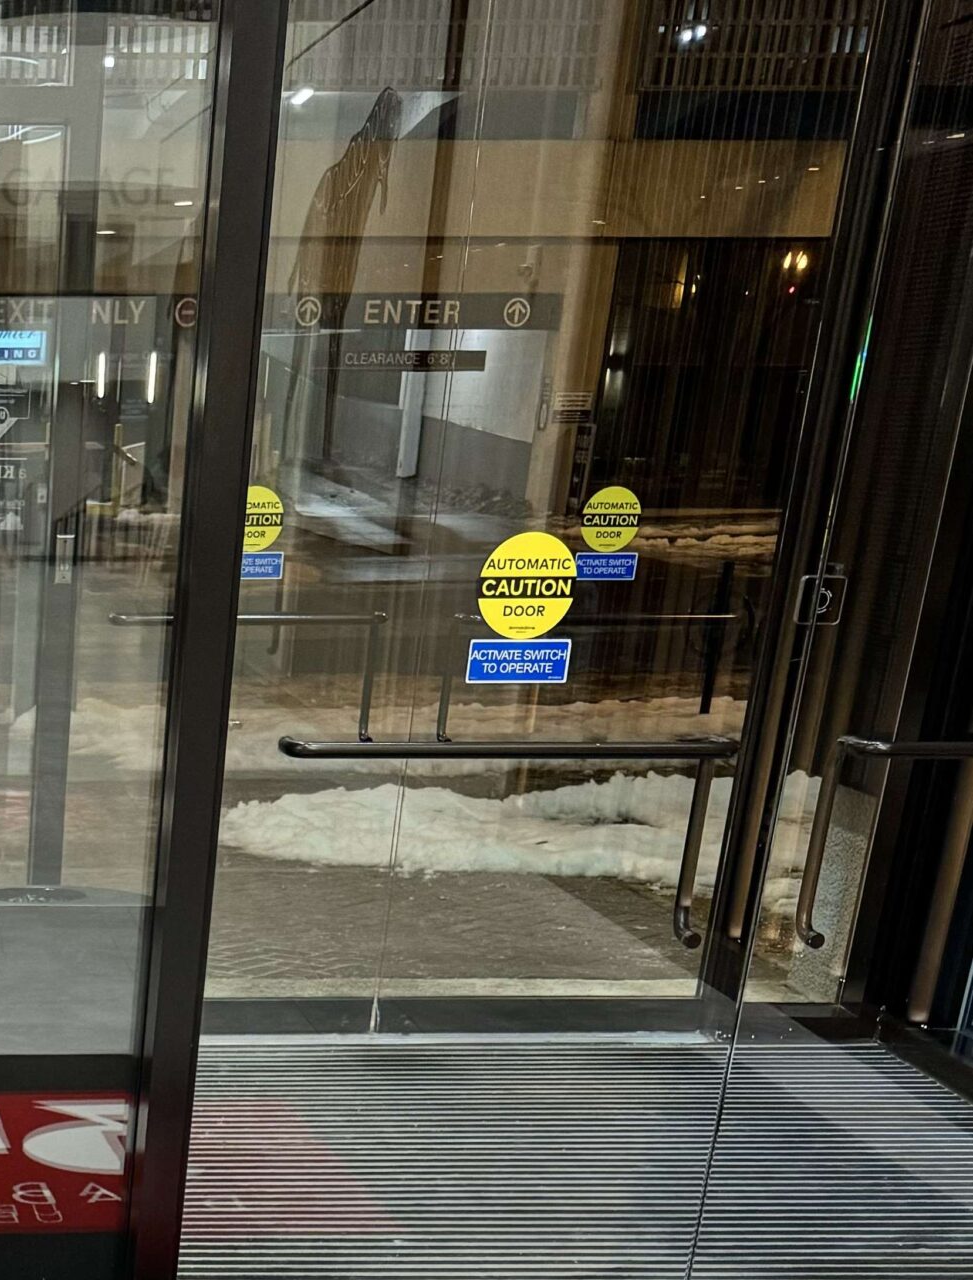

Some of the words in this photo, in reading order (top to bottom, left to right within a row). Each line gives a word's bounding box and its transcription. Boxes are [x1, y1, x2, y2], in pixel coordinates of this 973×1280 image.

[2, 166, 176, 208] GAAGE
[91, 300, 147, 325] NLY
[363, 299, 461, 325] ENTER
[344, 352, 421, 366] CLEARANCE
[246, 501, 281, 510] OMATIC
[586, 502, 639, 511] AUTOMATIC
[245, 514, 282, 526] UTION
[583, 515, 639, 526] CAUTION
[246, 530, 266, 538] OOR
[595, 531, 622, 539] DOOR
[486, 558, 572, 571] AUTOMATIC
[482, 578, 572, 596] CAUTION
[503, 605, 546, 617] DOOR
[470, 649, 522, 661] ACTIVATE
[523, 649, 567, 661] SWITCH
[481, 662, 497, 673] TO
[499, 662, 553, 674] OPERATE
